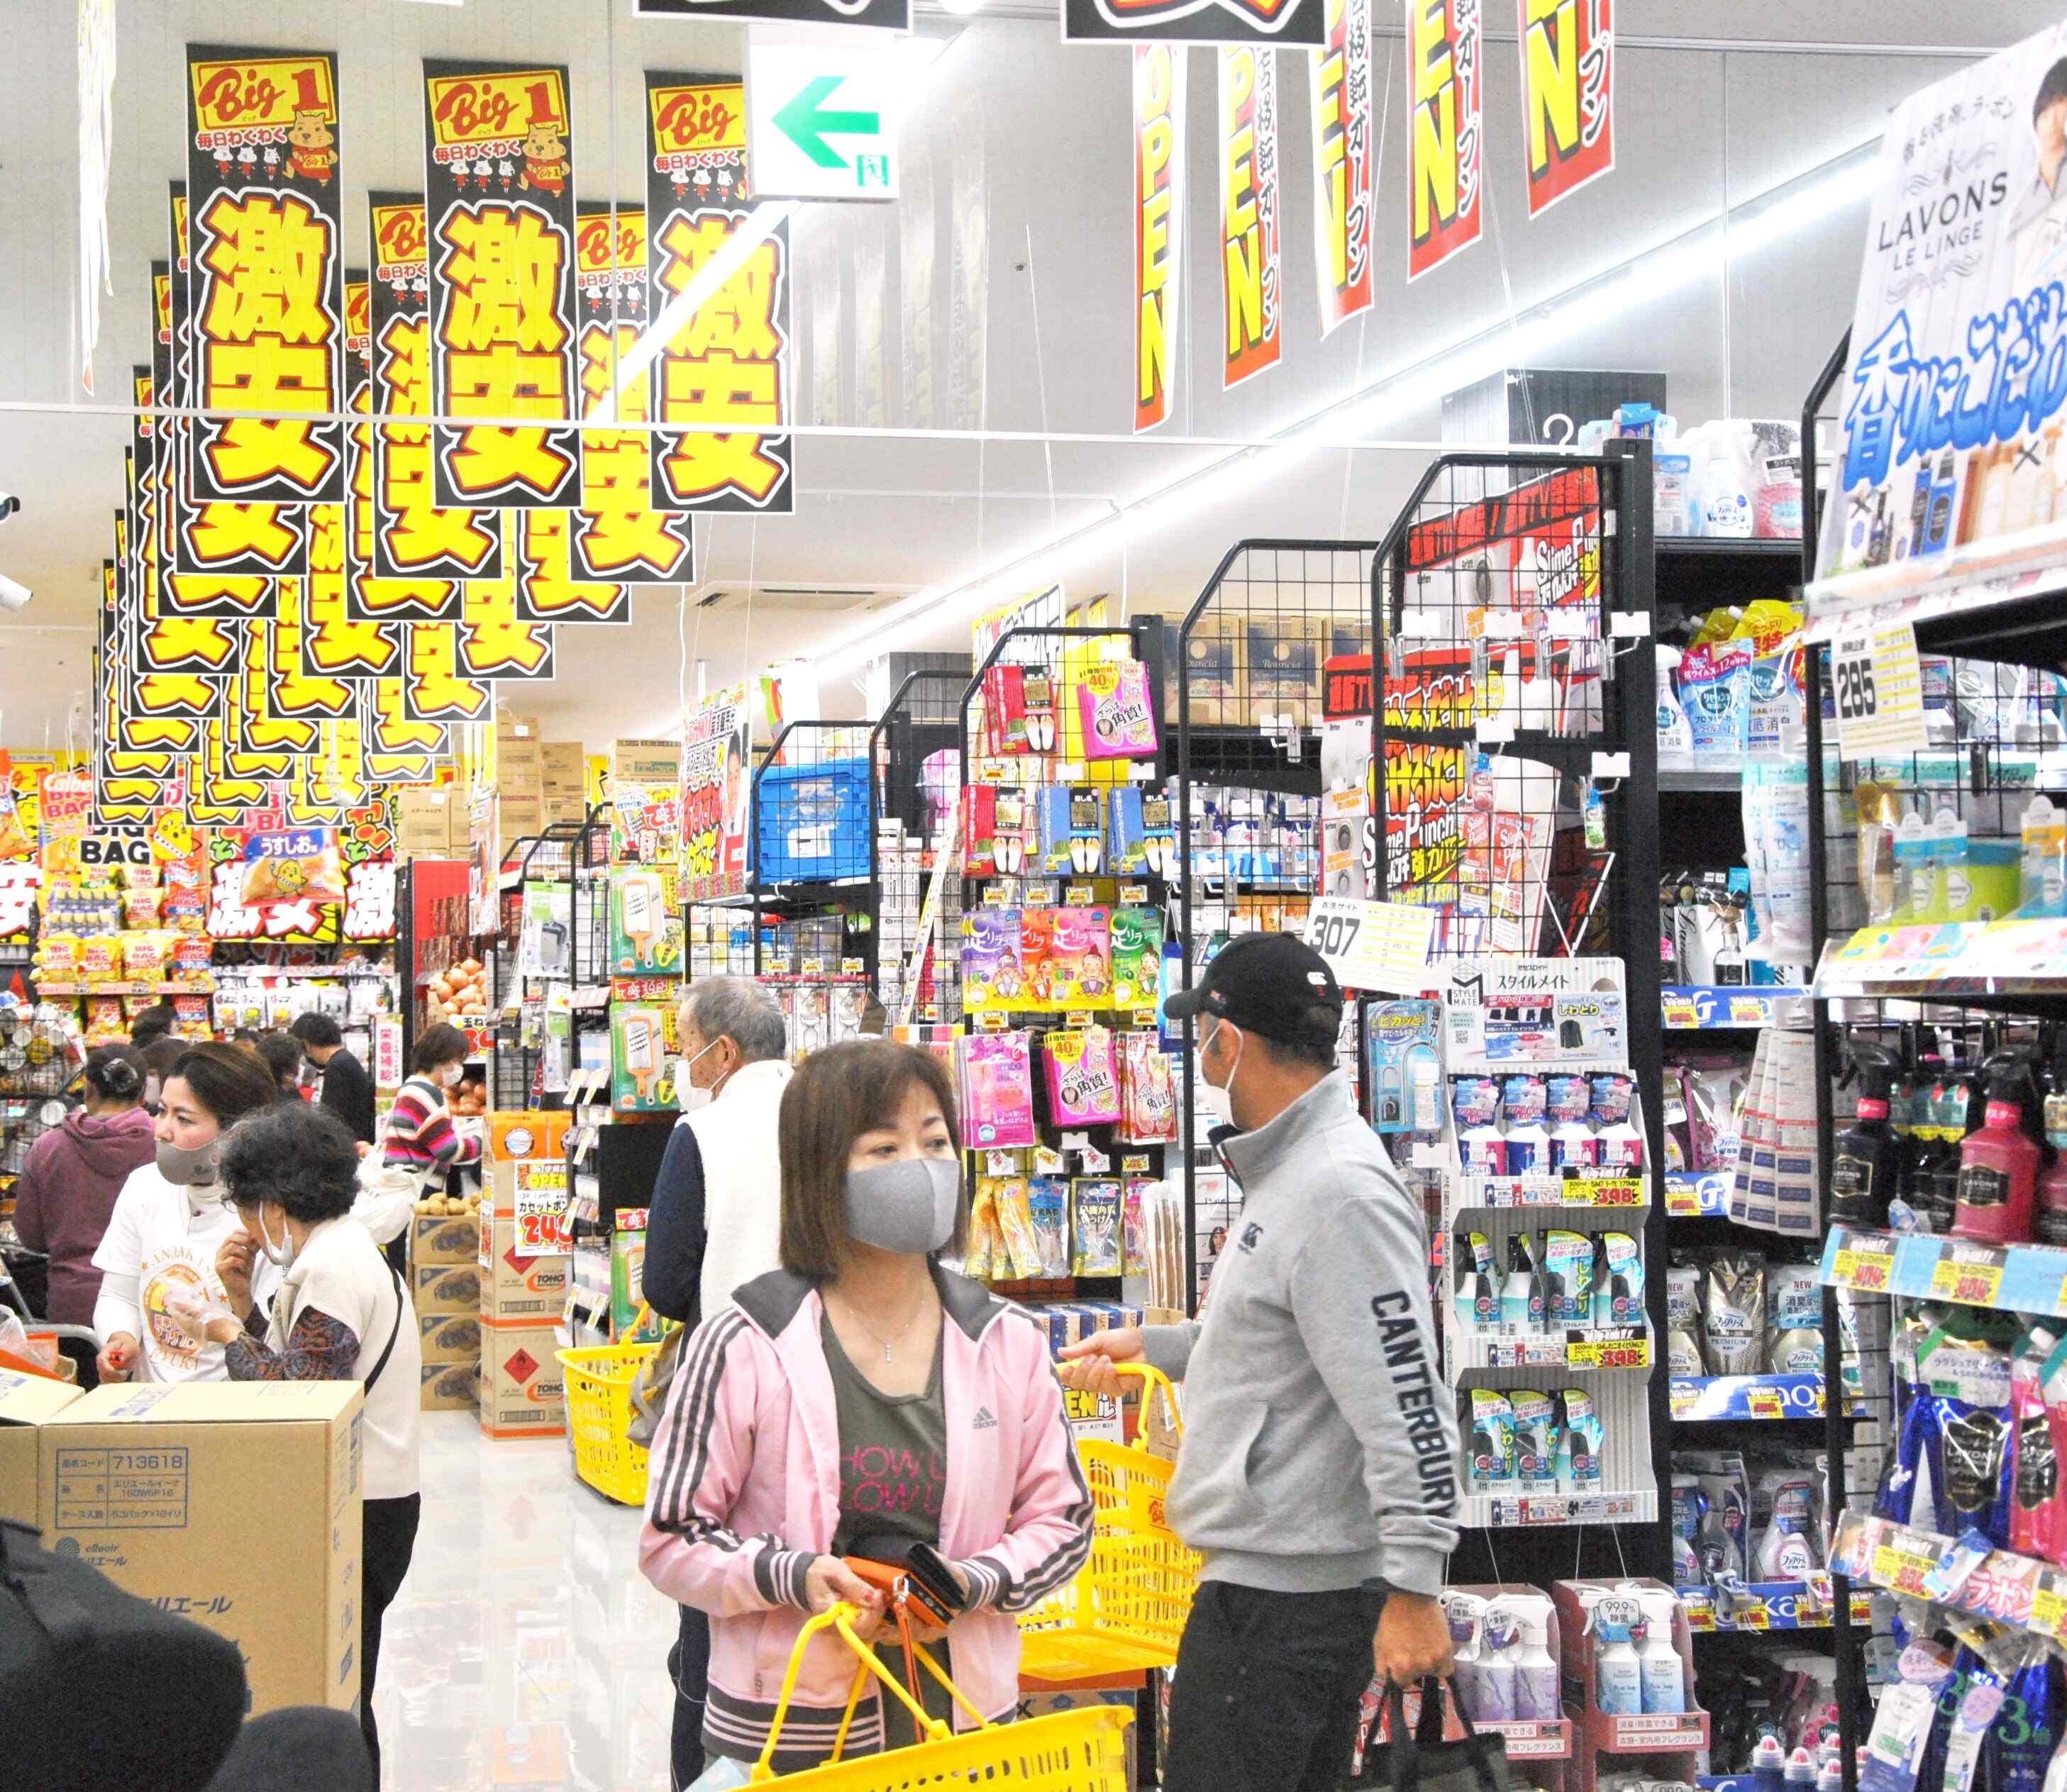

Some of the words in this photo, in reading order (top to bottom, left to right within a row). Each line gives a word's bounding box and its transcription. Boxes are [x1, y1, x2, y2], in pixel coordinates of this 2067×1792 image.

[198, 67, 286, 122] Big
[291, 68, 328, 112] 1
[435, 79, 519, 130] Big
[523, 82, 560, 123] 1
[655, 88, 738, 139] Big
[195, 127, 287, 149] 毎日わくわく
[434, 140, 521, 162] 毎日わくわく
[655, 150, 738, 172] 毎日わくわく
[1226, 47, 1263, 359] PEN
[1878, 170, 2008, 252] LAVONS
[379, 211, 427, 257] Bi
[1141, 45, 1173, 406] OPEN
[577, 219, 645, 267] Big
[1893, 245, 1917, 272] LE
[1924, 219, 1984, 260] LINGE
[377, 265, 427, 282] 毎日わく
[201, 193, 336, 491] 激安
[440, 205, 570, 496] 激安
[660, 213, 785, 501] 激安
[1837, 658, 1876, 719] 285
[1111, 703, 1144, 727] 角質!
[1406, 802, 1455, 854] Punch
[80, 840, 150, 865] BAG
[1309, 914, 1361, 957] 307
[1453, 989, 1478, 998] STYLE
[1497, 975, 1570, 989] スタイルメイト
[1453, 998, 1478, 1006] MATE
[1558, 1004, 1600, 1016] しわとり
[1076, 1072, 1109, 1096] 角質!
[1597, 1188, 1634, 1205] 398
[1793, 1280, 1812, 1289] NEW
[1602, 1349, 1638, 1366] 398
[1370, 1289, 1457, 1518] CANTERBURY
[112, 1454, 182, 1470] 713618
[79, 1556, 128, 1567] リエール
[148, 1596, 233, 1615] リエール
[1609, 1613, 1629, 1623] 除菌
